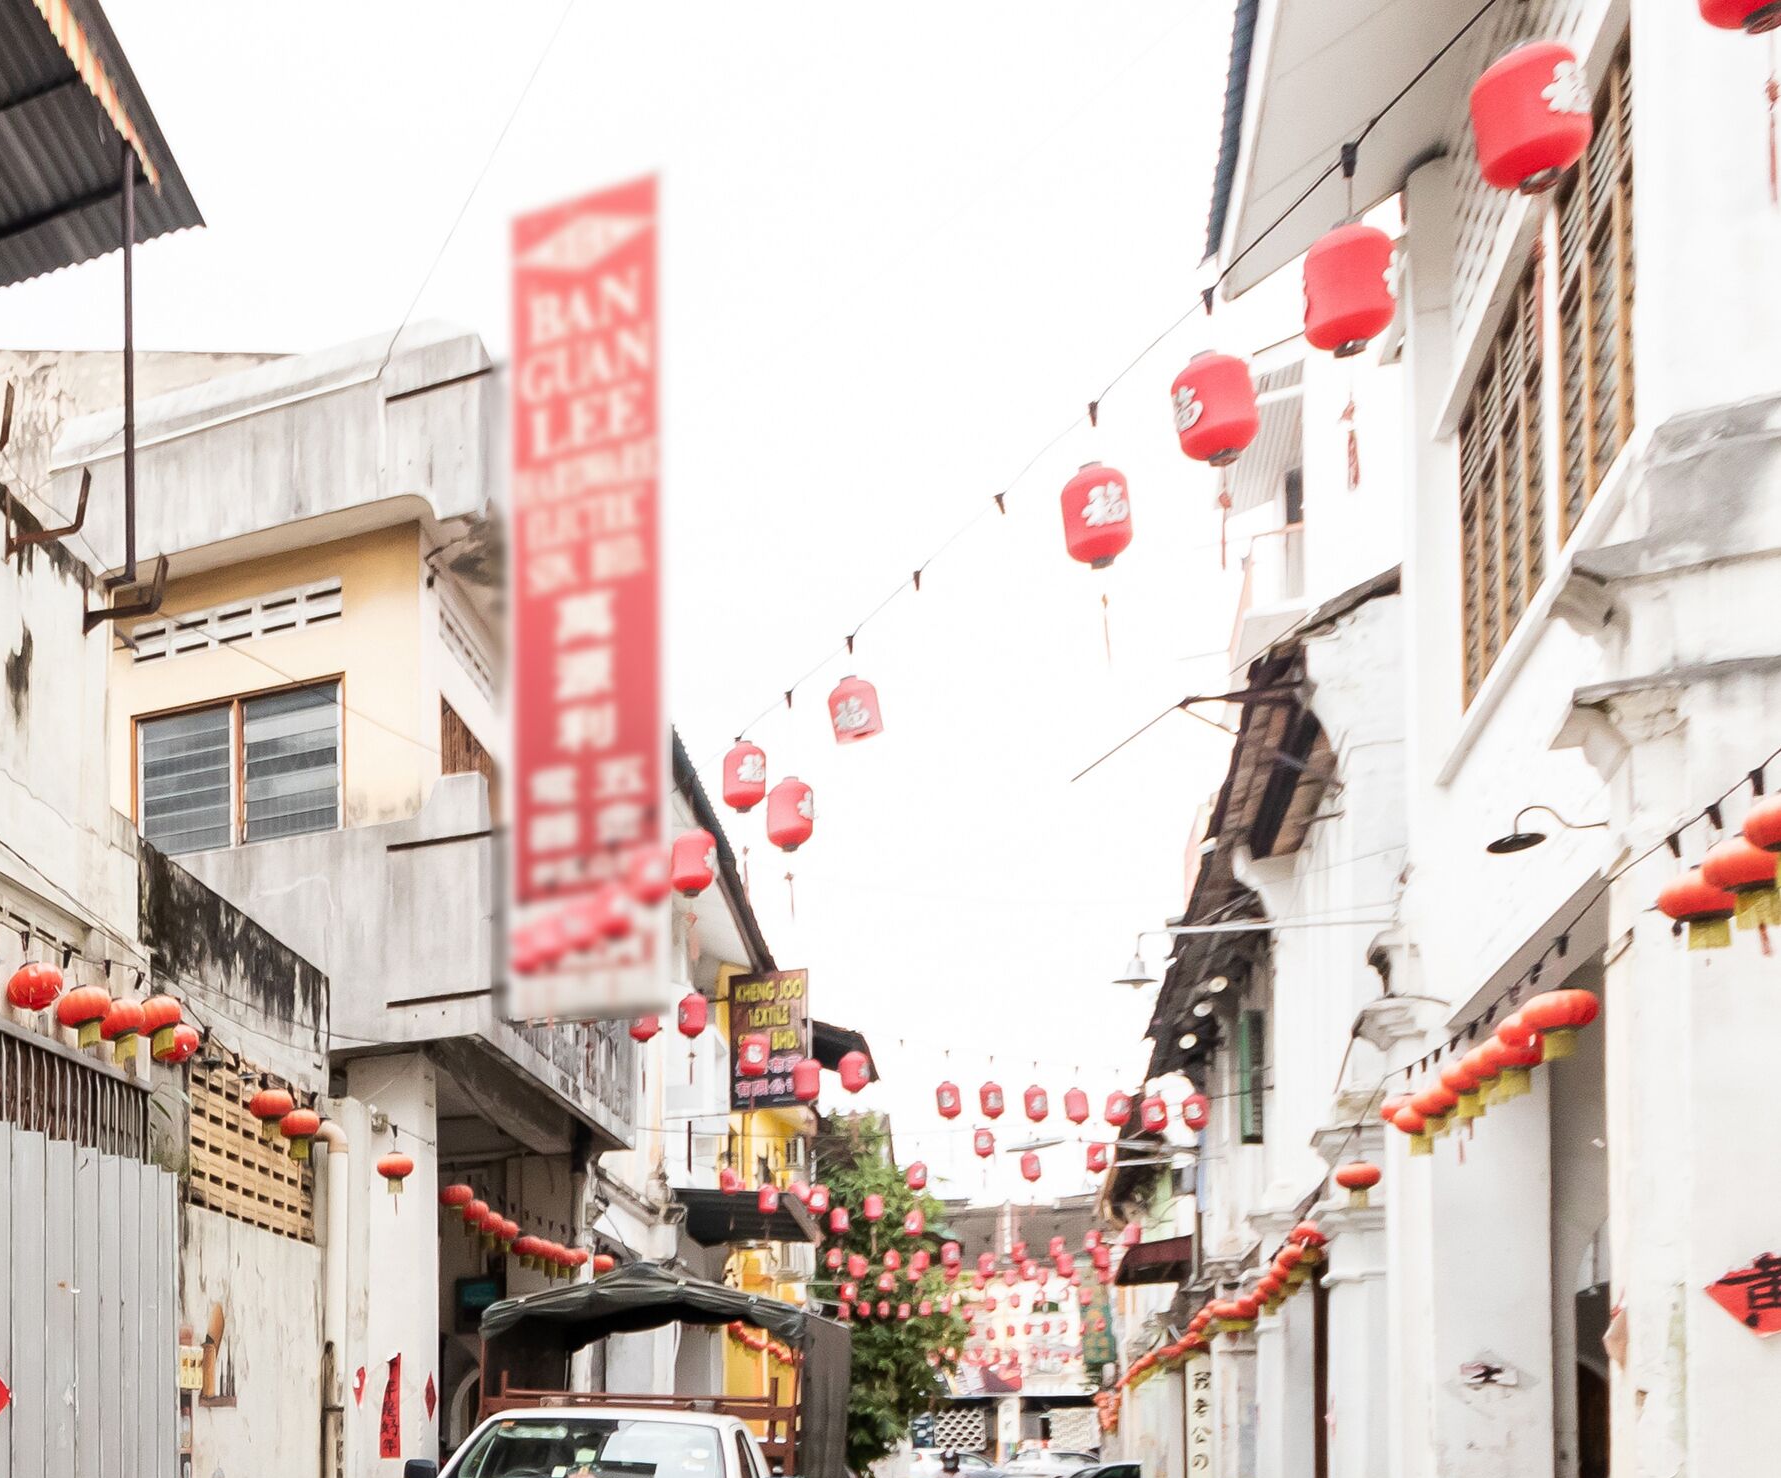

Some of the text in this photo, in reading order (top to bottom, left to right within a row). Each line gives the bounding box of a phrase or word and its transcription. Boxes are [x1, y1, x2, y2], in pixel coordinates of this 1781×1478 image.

[529, 264, 640, 348] BAN
[531, 381, 647, 459] LEE
[735, 978, 803, 1003] KHENG JOO
